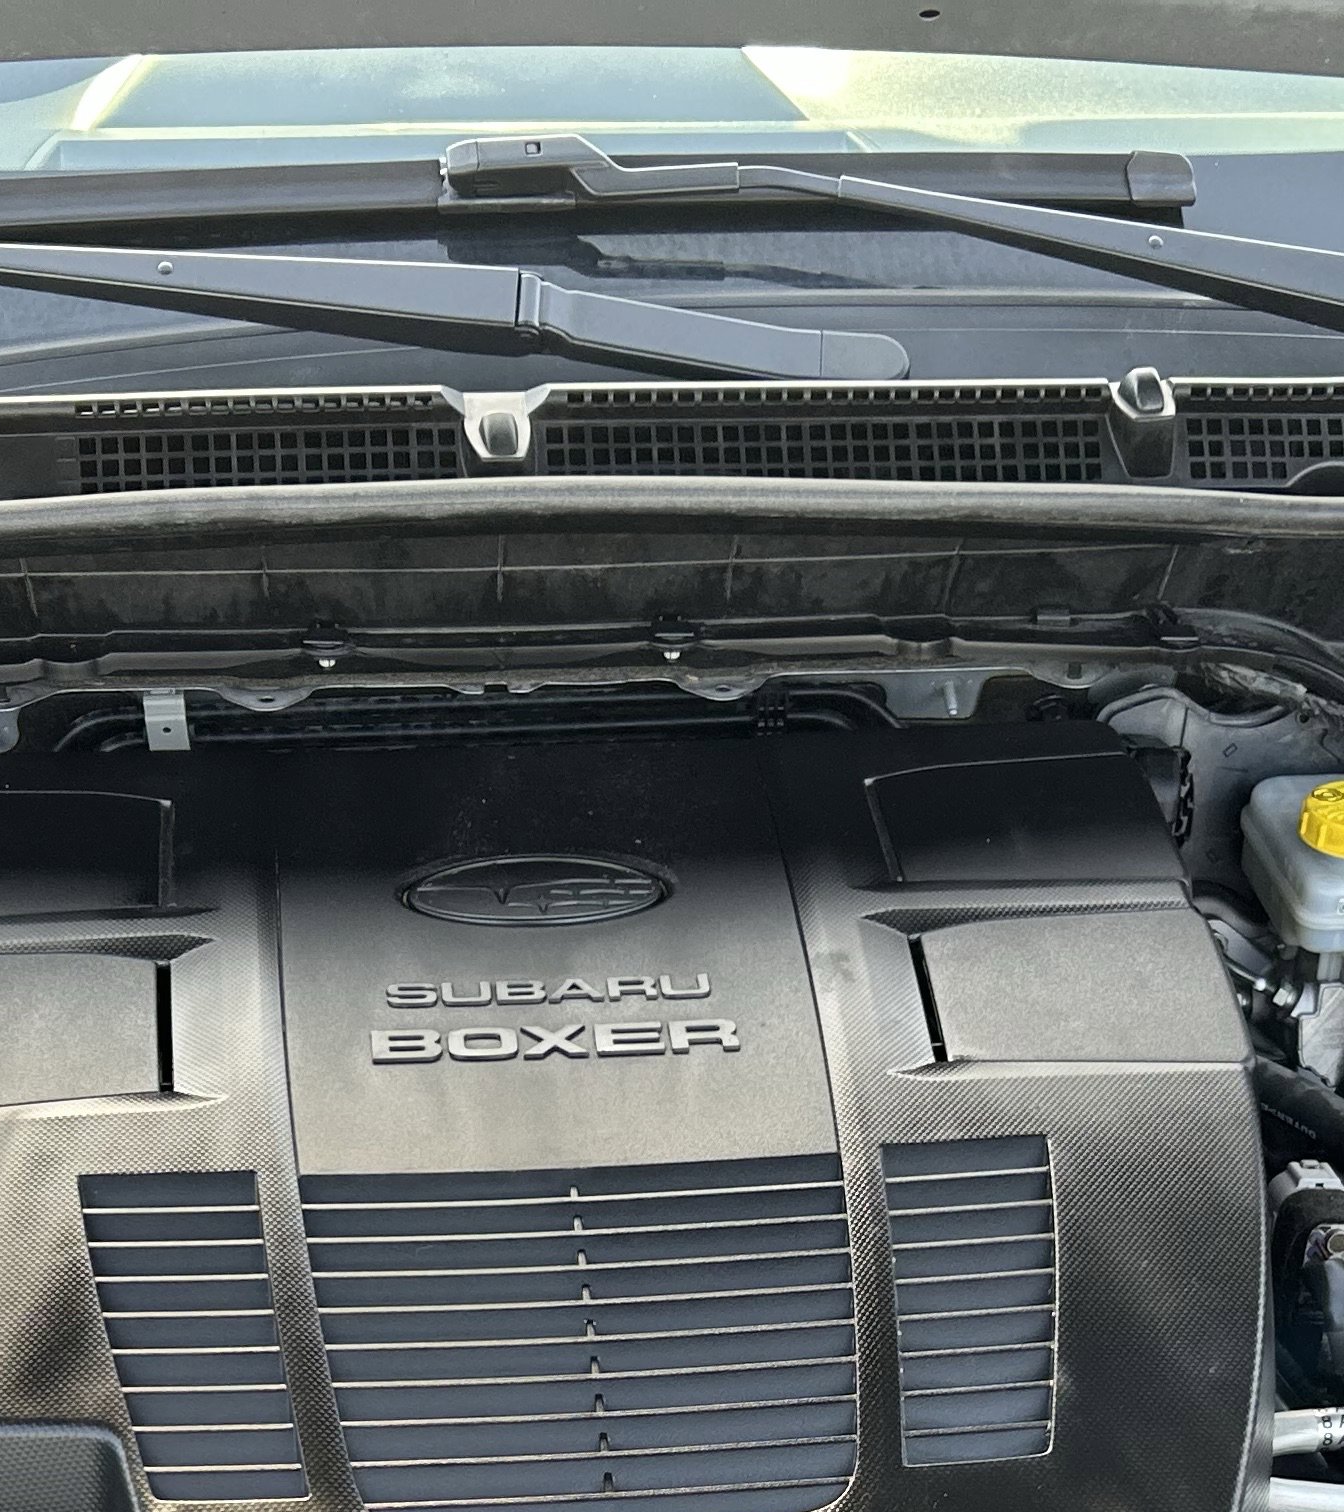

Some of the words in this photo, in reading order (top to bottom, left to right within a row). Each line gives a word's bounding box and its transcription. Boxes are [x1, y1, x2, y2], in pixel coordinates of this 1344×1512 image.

[386, 972, 711, 1008] SUBARU
[370, 1018, 741, 1065] BOXER
[1322, 1415, 1333, 1429] 8
[1322, 1432, 1333, 1446] 8
